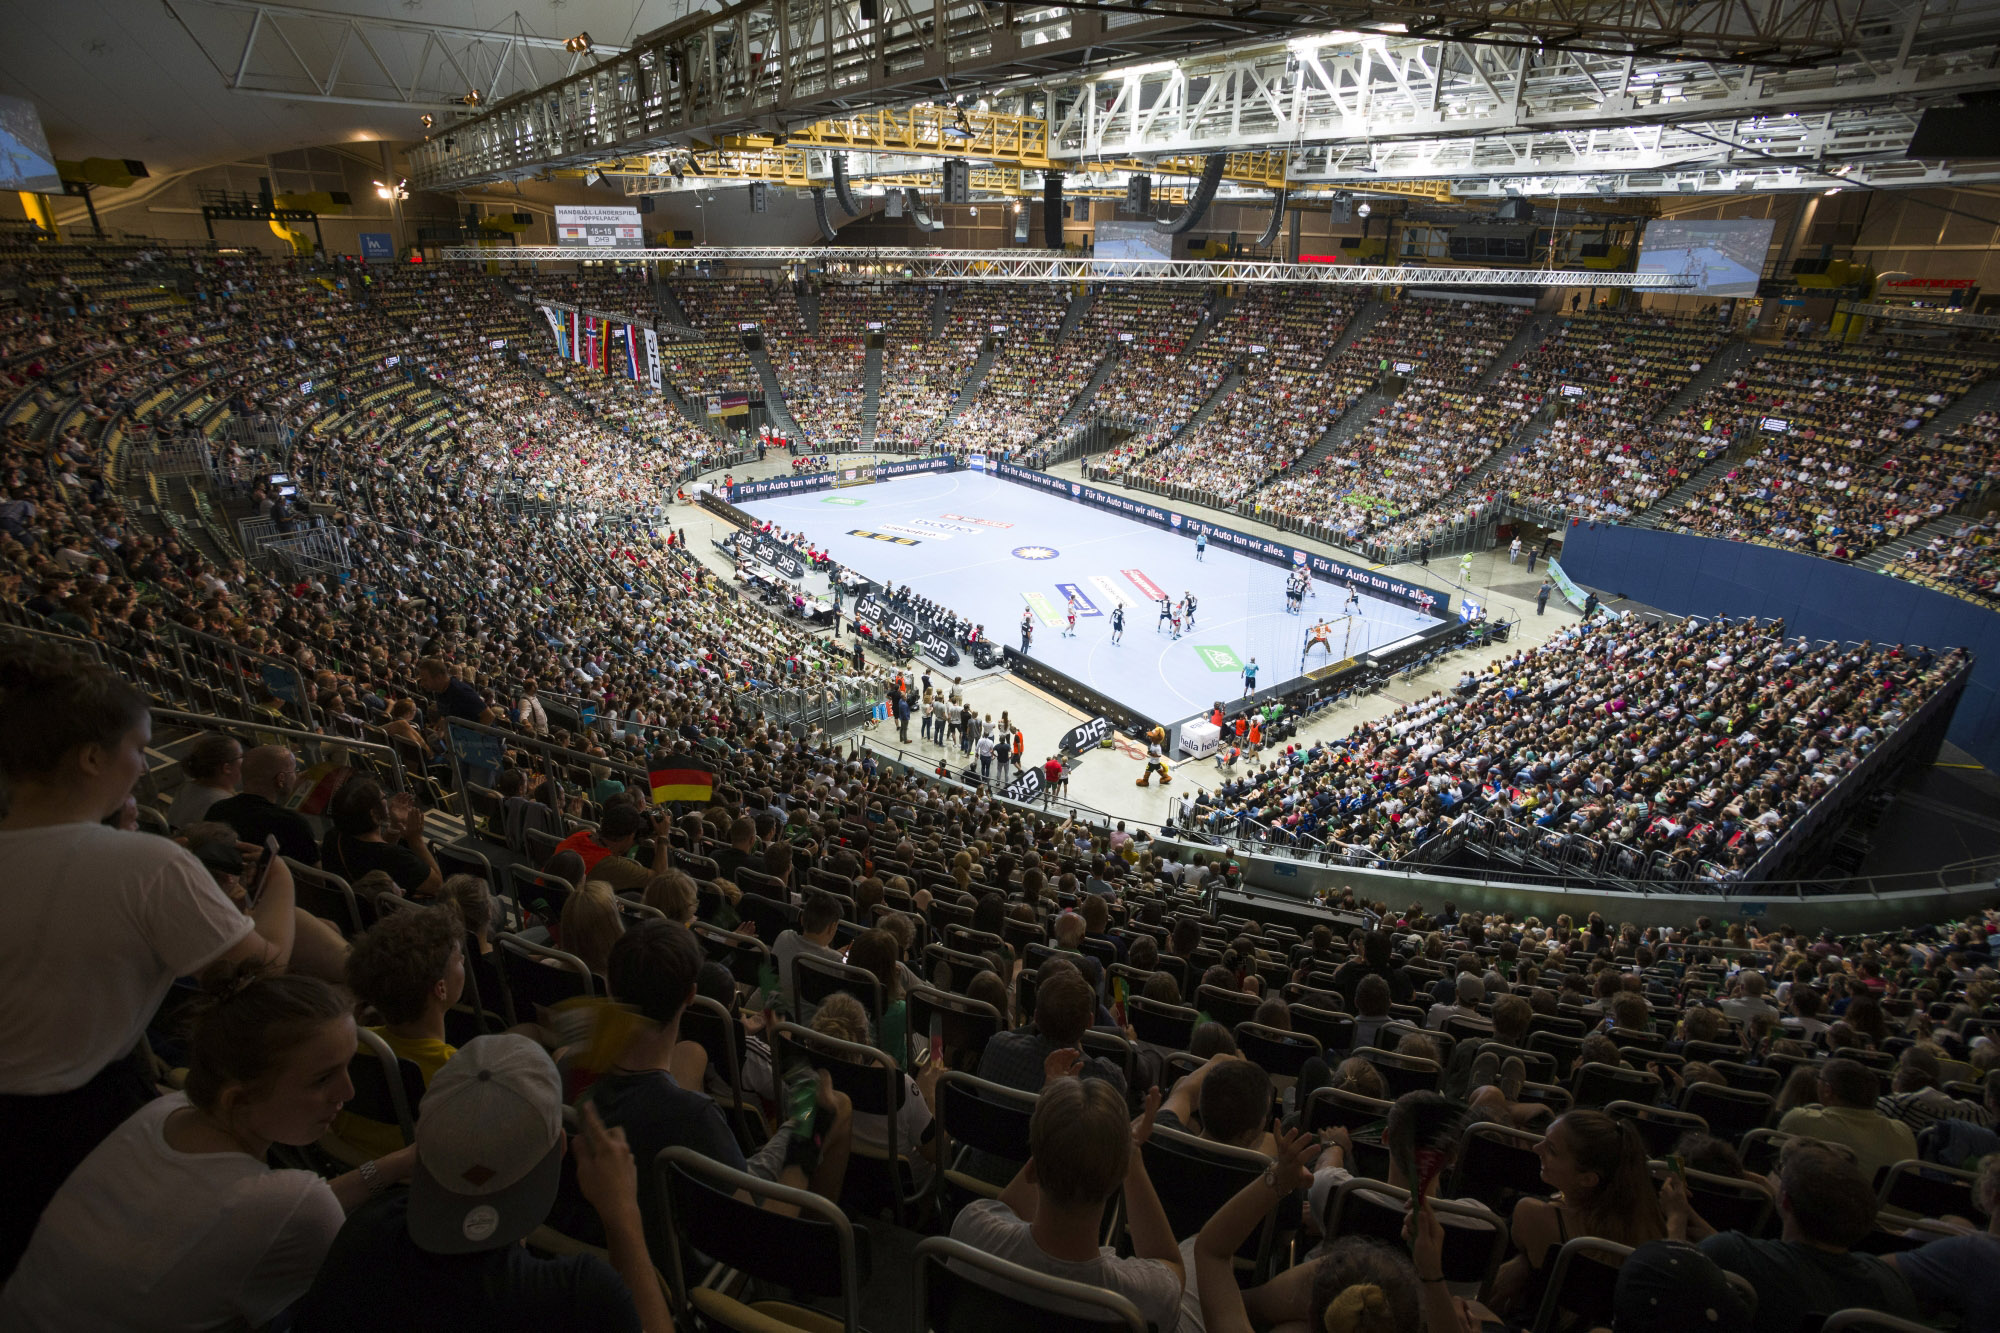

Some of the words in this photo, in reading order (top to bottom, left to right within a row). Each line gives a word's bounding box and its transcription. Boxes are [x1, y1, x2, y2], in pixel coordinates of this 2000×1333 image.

[862, 468, 874, 477] Für
[887, 466, 904, 474] Auto
[918, 461, 929, 469] wir
[930, 460, 948, 468] alles.
[1000, 464, 1010, 473] Für
[1010, 467, 1018, 476] Ihr
[1018, 470, 1032, 480] Auto
[1032, 474, 1041, 483] tun
[1042, 476, 1051, 486] wir
[1052, 480, 1068, 491] alles.
[740, 484, 754, 495] Für
[756, 484, 767, 492] Ihr
[769, 482, 788, 490] Auto
[790, 480, 804, 488] tun
[805, 477, 818, 485] wir
[818, 474, 837, 483] alles
[1085, 489, 1096, 499] Für
[1096, 492, 1106, 502] Ihr
[1106, 496, 1122, 508] Auto
[1122, 501, 1134, 511] tun
[1135, 505, 1146, 514] wir
[1146, 508, 1165, 520] alles.
[1187, 520, 1200, 532] Für
[1201, 524, 1212, 534] Ihr
[1213, 528, 1232, 541] Auto
[1233, 534, 1247, 546] tun
[1248, 540, 1262, 550] wir
[1263, 544, 1286, 558] alles.
[1313, 558, 1330, 571] Für
[1331, 563, 1344, 576] Ihr
[1345, 568, 1369, 584] Auto
[1372, 576, 1388, 590] tun
[1390, 582, 1407, 595] wir
[1408, 589, 1437, 605] als.
[1180, 734, 1199, 752] hella
